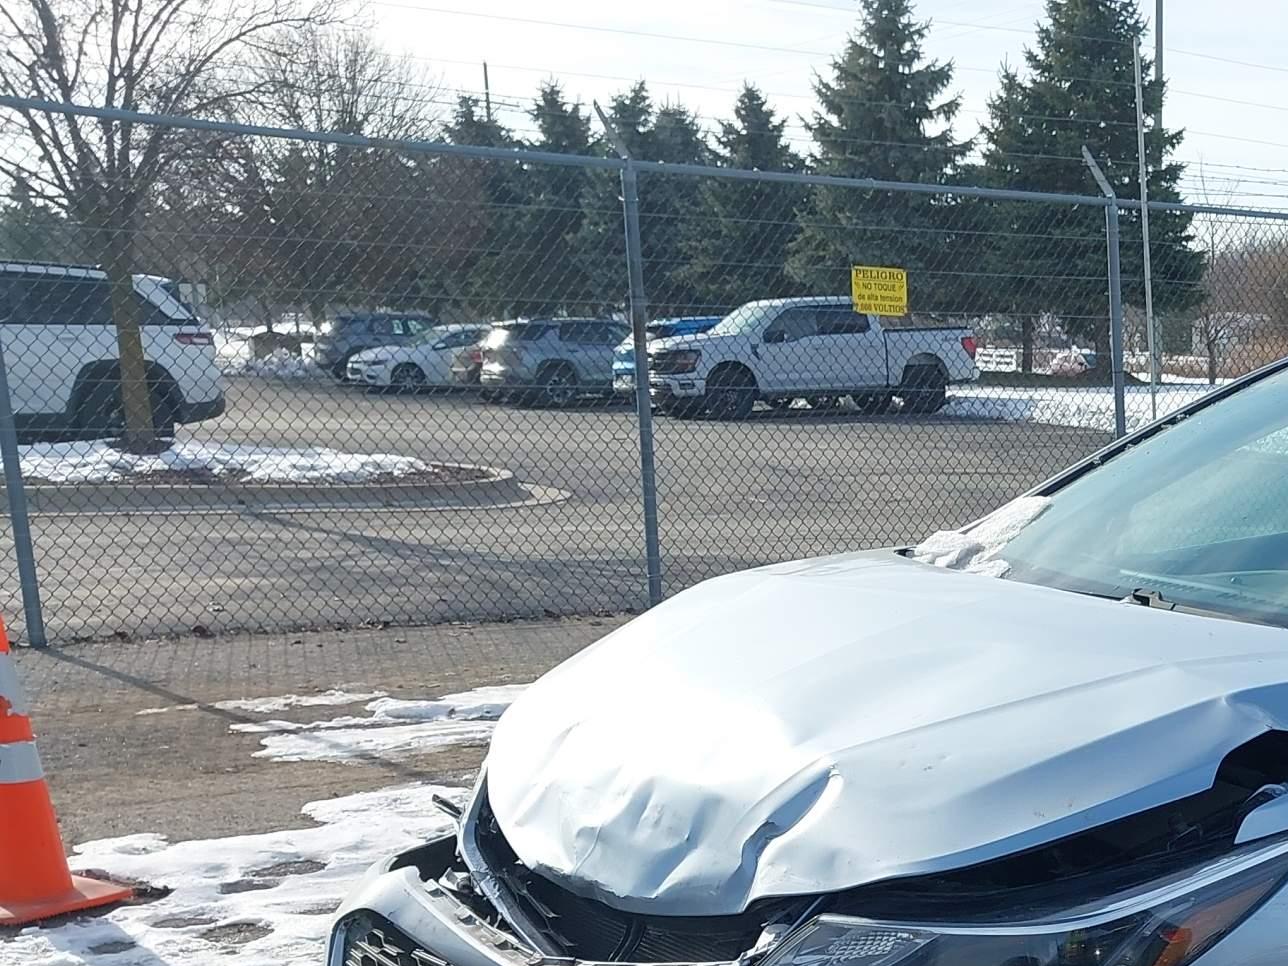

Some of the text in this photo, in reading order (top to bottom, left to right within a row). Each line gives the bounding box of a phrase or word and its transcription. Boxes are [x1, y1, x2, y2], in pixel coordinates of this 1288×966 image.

[855, 269, 904, 281] PELIGRO
[862, 282, 896, 292] NO TOQUE
[873, 303, 905, 313] VOLTIOS
